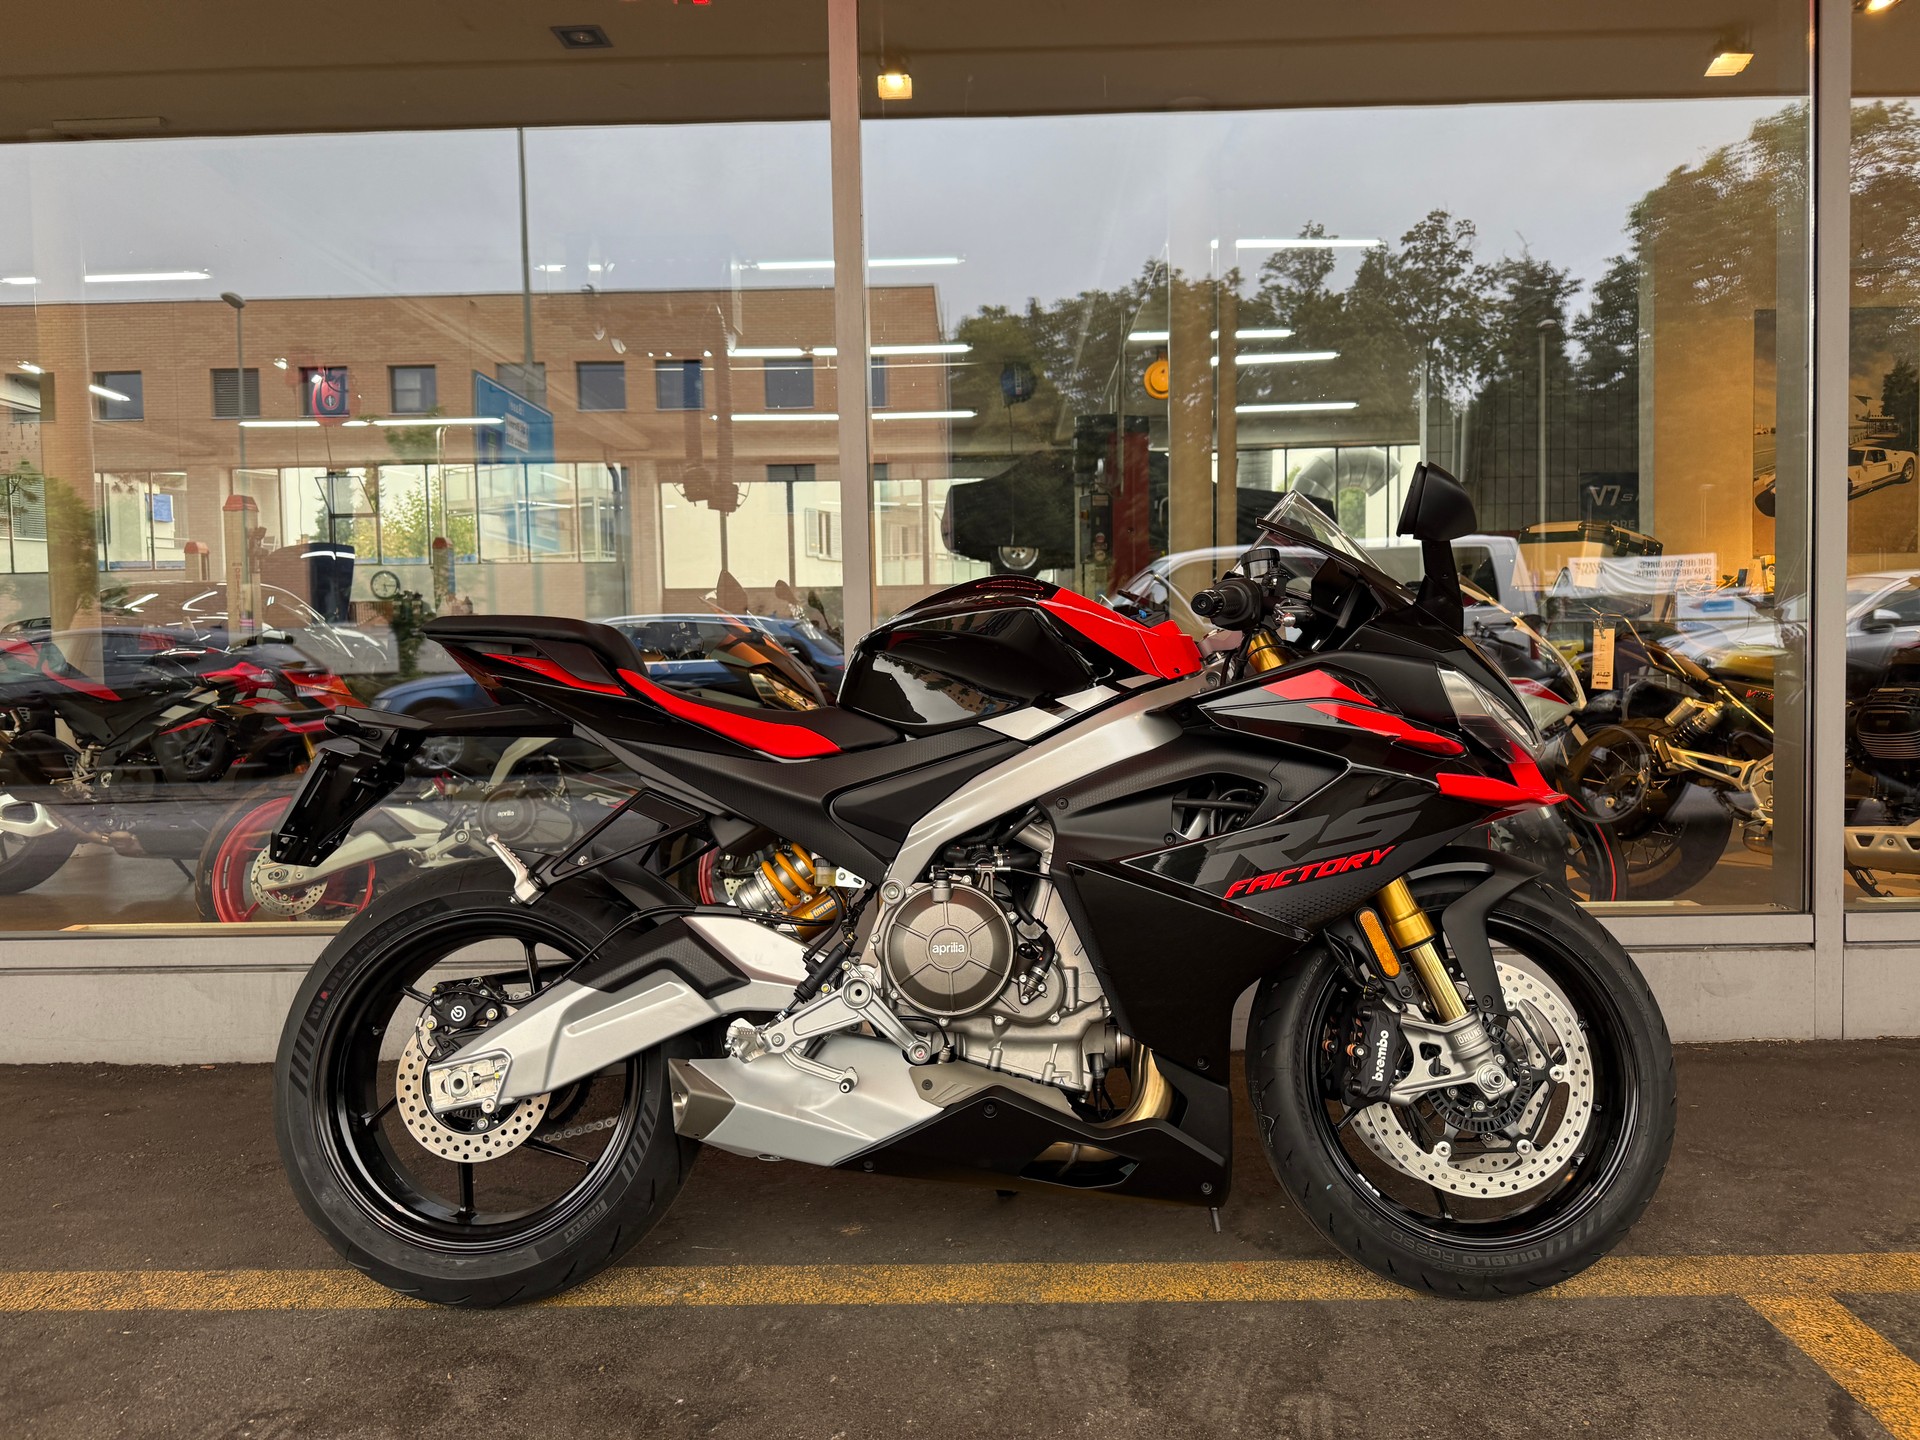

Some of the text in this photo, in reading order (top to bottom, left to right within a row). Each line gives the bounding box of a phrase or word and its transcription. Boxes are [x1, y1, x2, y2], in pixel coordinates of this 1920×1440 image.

[1588, 485, 1621, 507] V7
[1223, 846, 1396, 900] FACTORY
[932, 941, 965, 956] aprilia
[1371, 1030, 1389, 1082] brembo
[563, 1199, 608, 1244] PIRELLI
[1390, 1229, 1455, 1263] ROSSO
[1462, 1248, 1543, 1268] DIABLO
